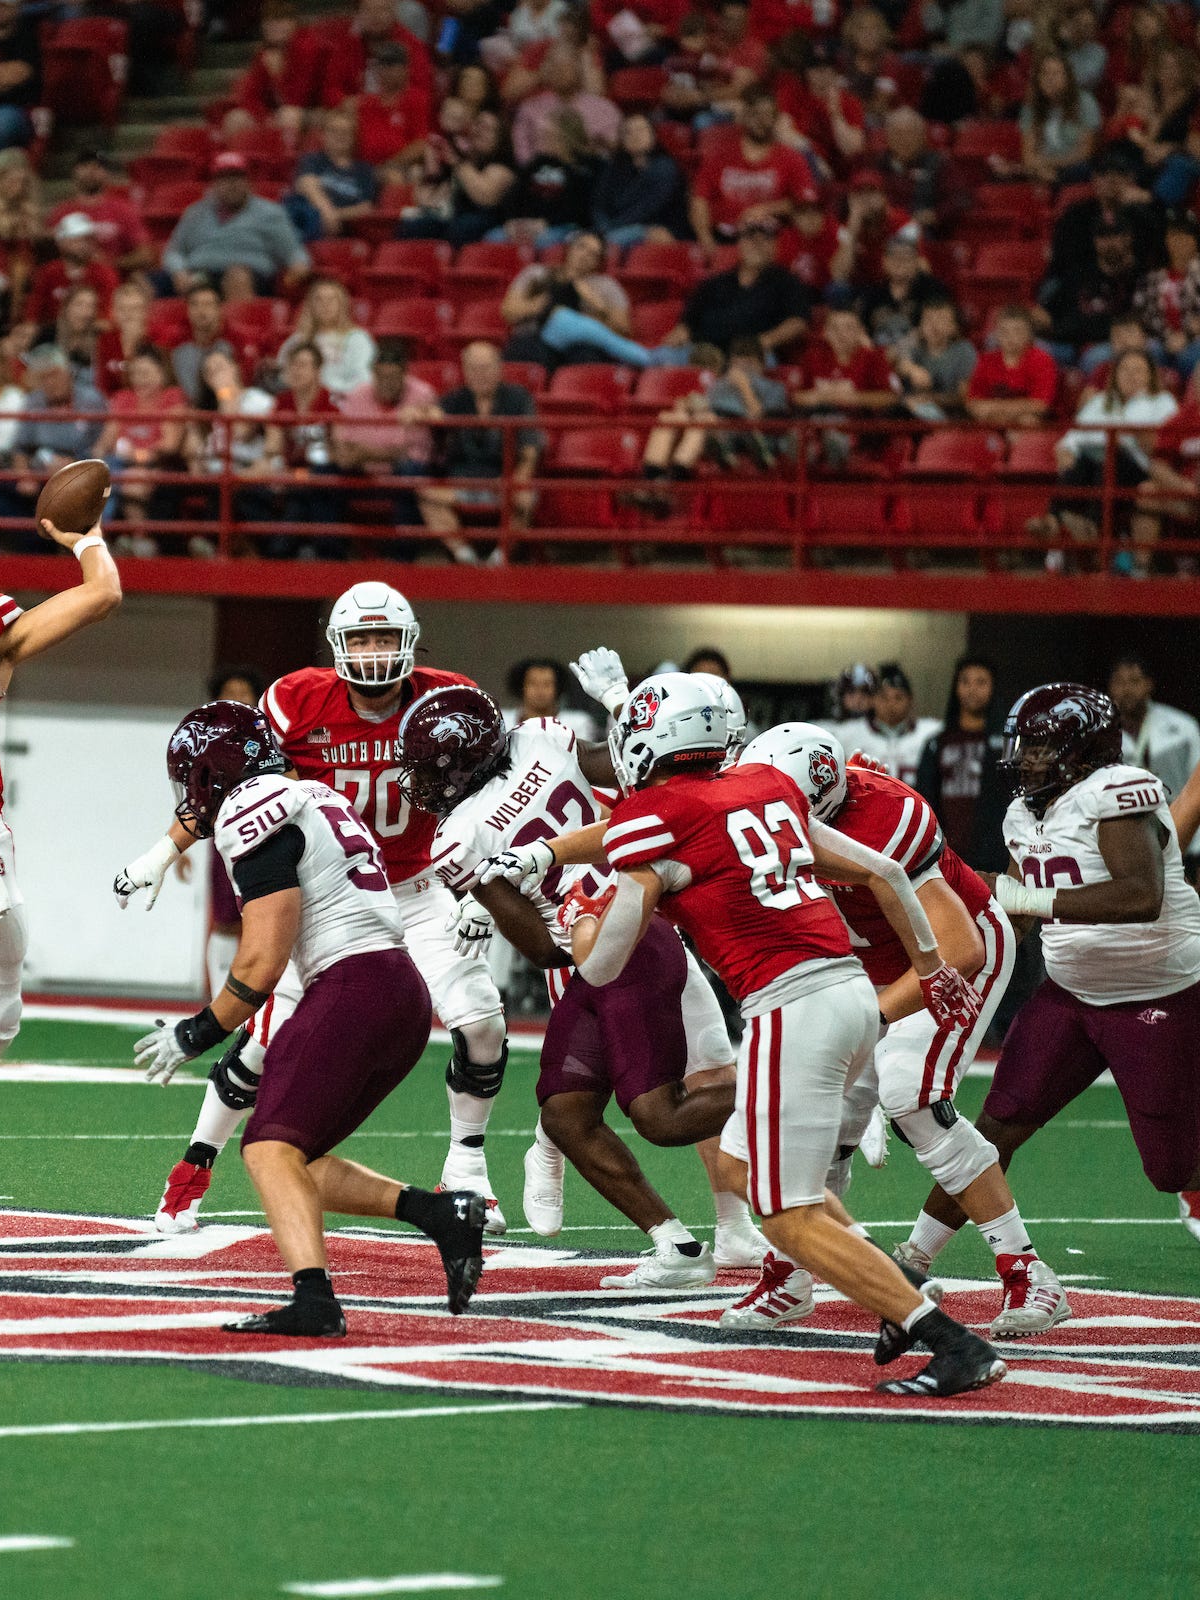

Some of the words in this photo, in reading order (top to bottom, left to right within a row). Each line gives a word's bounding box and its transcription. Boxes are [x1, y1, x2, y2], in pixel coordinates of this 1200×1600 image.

[321, 741, 368, 763] SOUTH
[673, 752, 705, 762] SOUTH
[334, 766, 412, 838] 70
[485, 760, 552, 832] WILBERT
[1115, 788, 1160, 811] SIU
[237, 802, 288, 845] SIU
